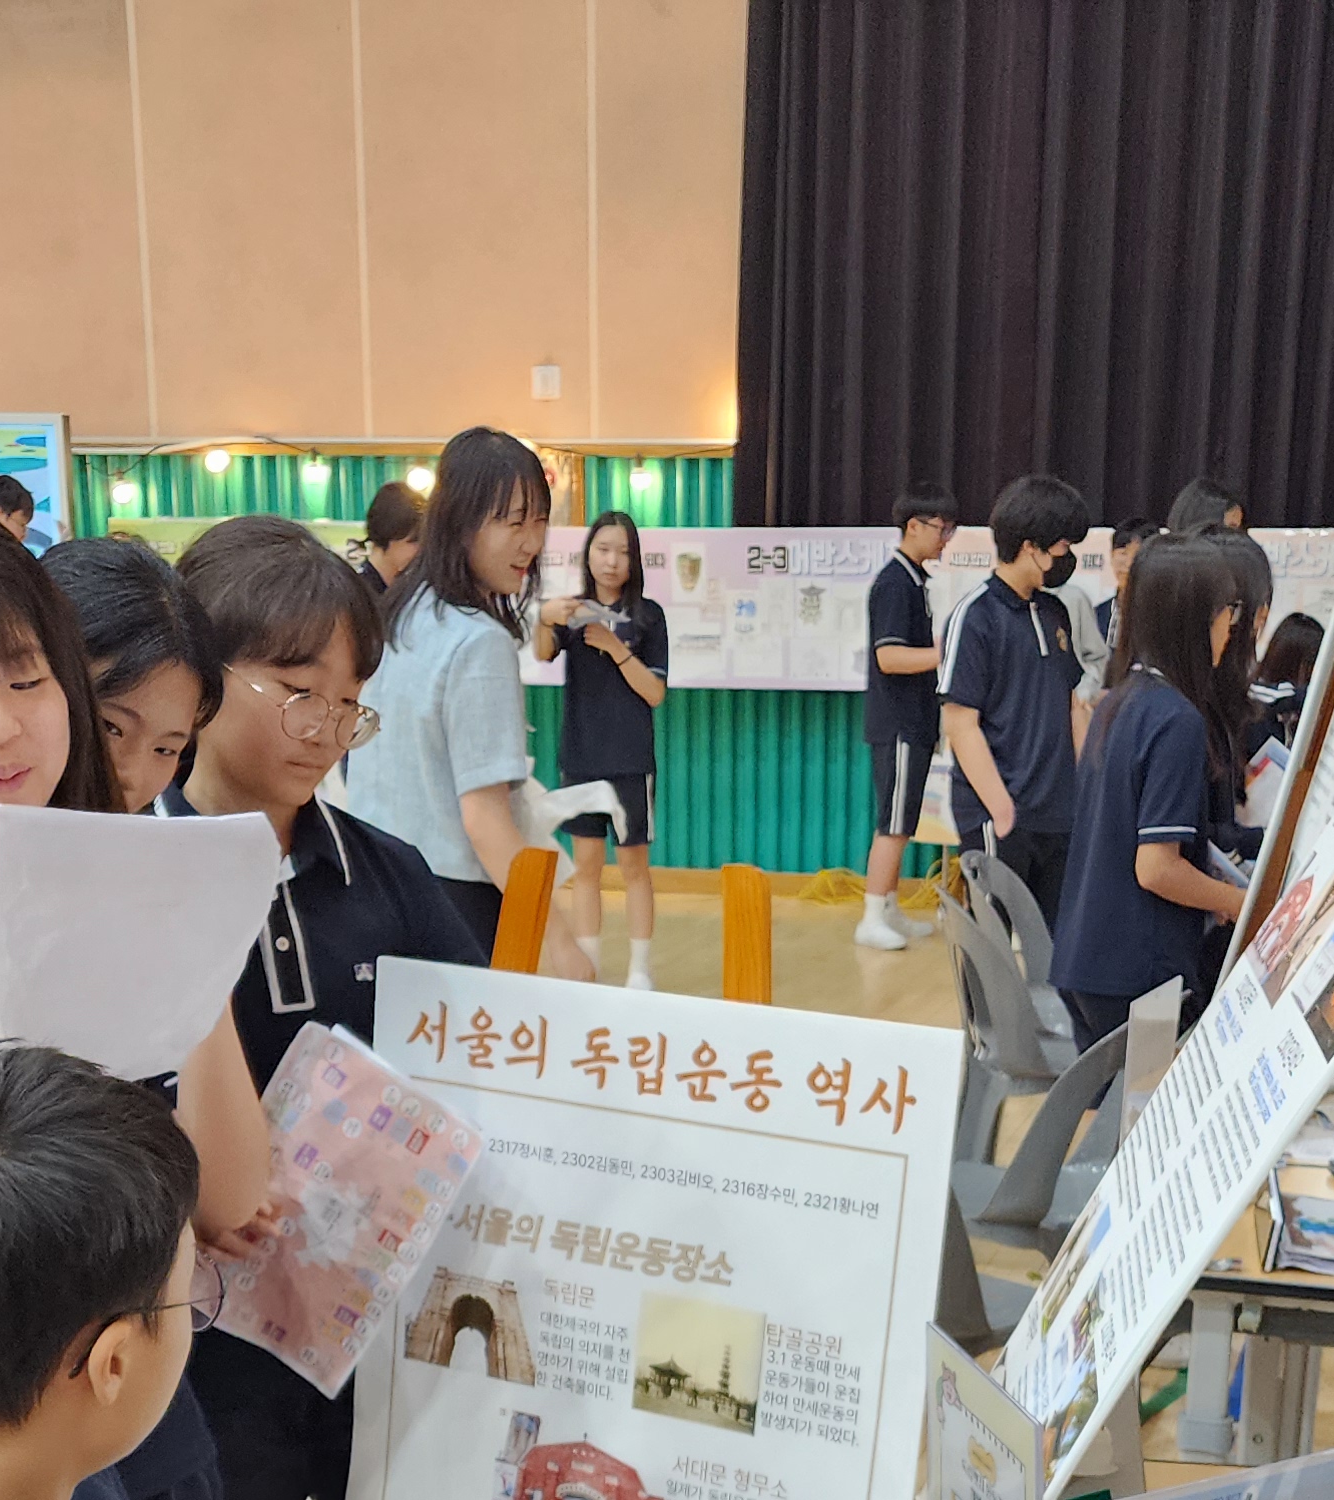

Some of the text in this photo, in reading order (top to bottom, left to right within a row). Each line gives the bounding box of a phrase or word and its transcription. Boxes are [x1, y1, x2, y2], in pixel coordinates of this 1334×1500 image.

[747, 539, 899, 576] 2-3 어반스케
[407, 1001, 917, 1135] 서울의 독립운동 역사
[488, 1138, 879, 1218] 2317정시훈, 2302김동민, 2303김비오, 2316장수민, 2321황나연
[550, 1219, 734, 1286] 독립운동장소
[544, 1279, 595, 1309] 독립문
[540, 1311, 629, 1342] 대한제국의 자주
[767, 1323, 842, 1359] 탑골공원
[539, 1331, 574, 1353] 독립의
[579, 1340, 614, 1362] 의지를
[578, 1359, 601, 1378] 위해
[605, 1366, 629, 1385] 설립
[767, 1350, 861, 1382] 3.1 운동때 만세
[536, 1370, 613, 1401] 한 건축물이다.
[765, 1370, 861, 1405] 운동가들이 운집
[763, 1390, 858, 1425] 하여 만세운동의
[761, 1410, 859, 1446] 발생지가 되었다.
[666, 1480, 702, 1500] 일제가
[672, 1456, 788, 1500] 서대문 형무소
